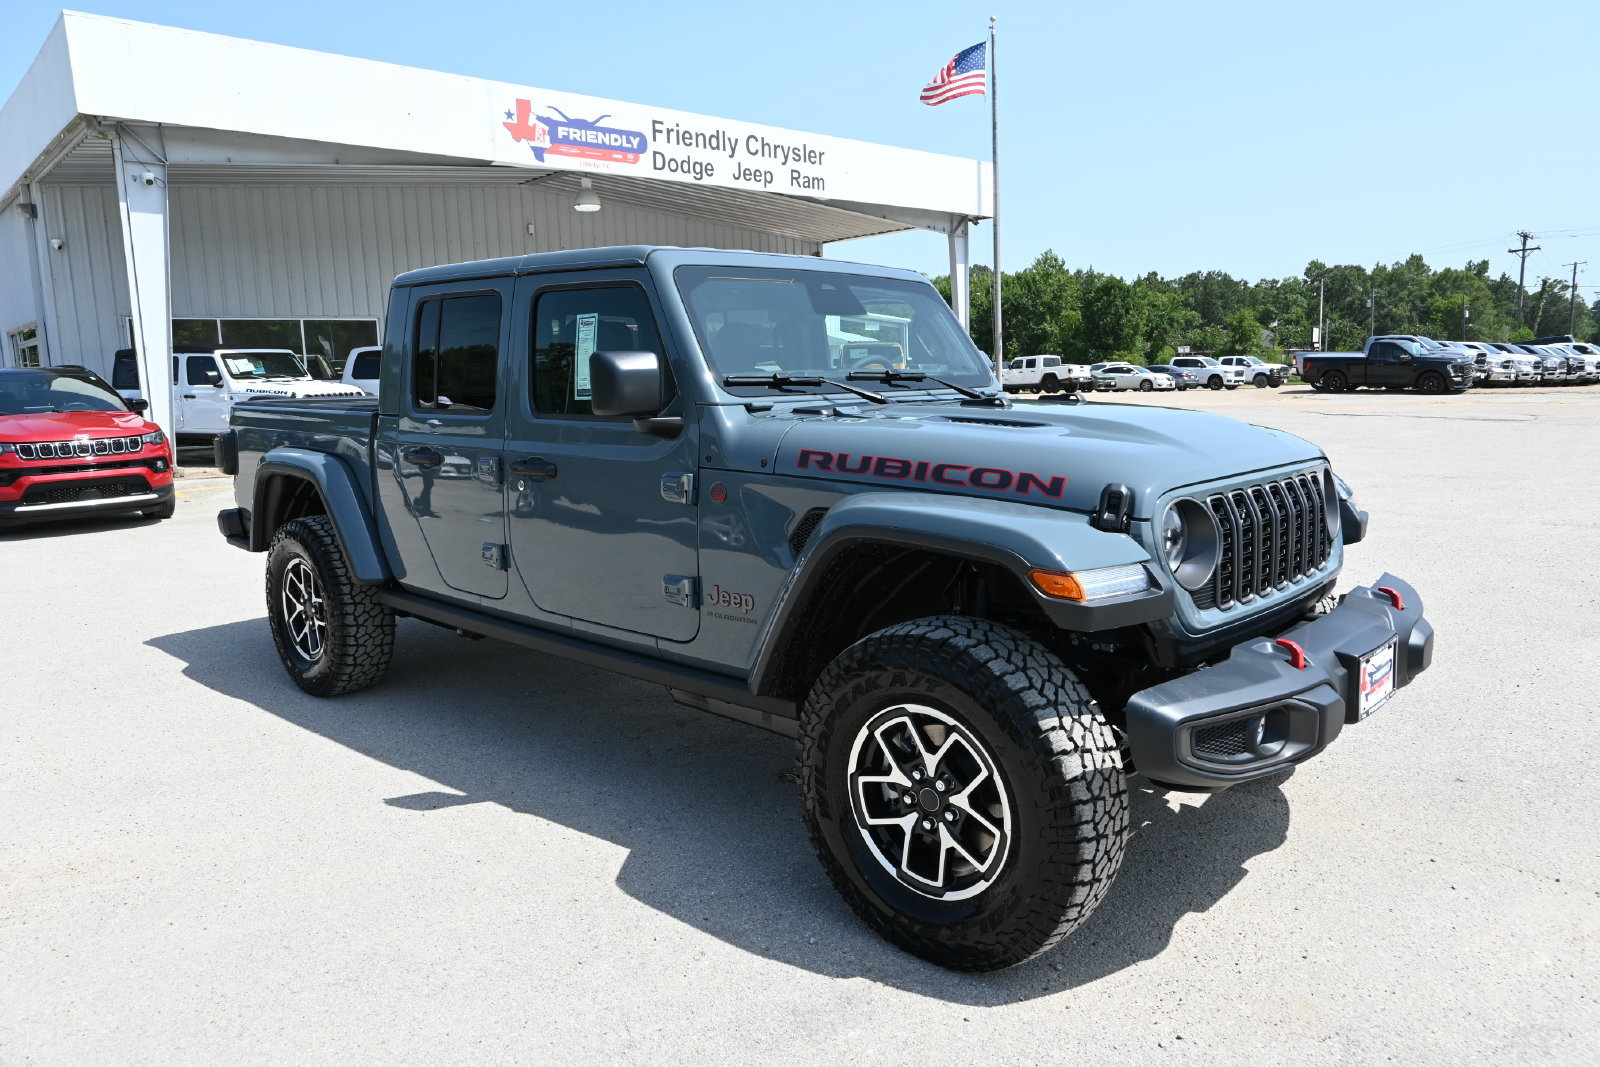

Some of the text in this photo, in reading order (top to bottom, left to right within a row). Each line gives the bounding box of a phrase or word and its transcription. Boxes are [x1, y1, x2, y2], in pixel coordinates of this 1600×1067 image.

[557, 126, 641, 150] FRIENDLY
[652, 119, 825, 166] Friendly Chrysler
[652, 150, 825, 191] Dodge Jeep Ram
[797, 449, 1068, 499] RUBICON
[706, 584, 755, 614] Jeep
[714, 612, 758, 625] GLADIATOR
